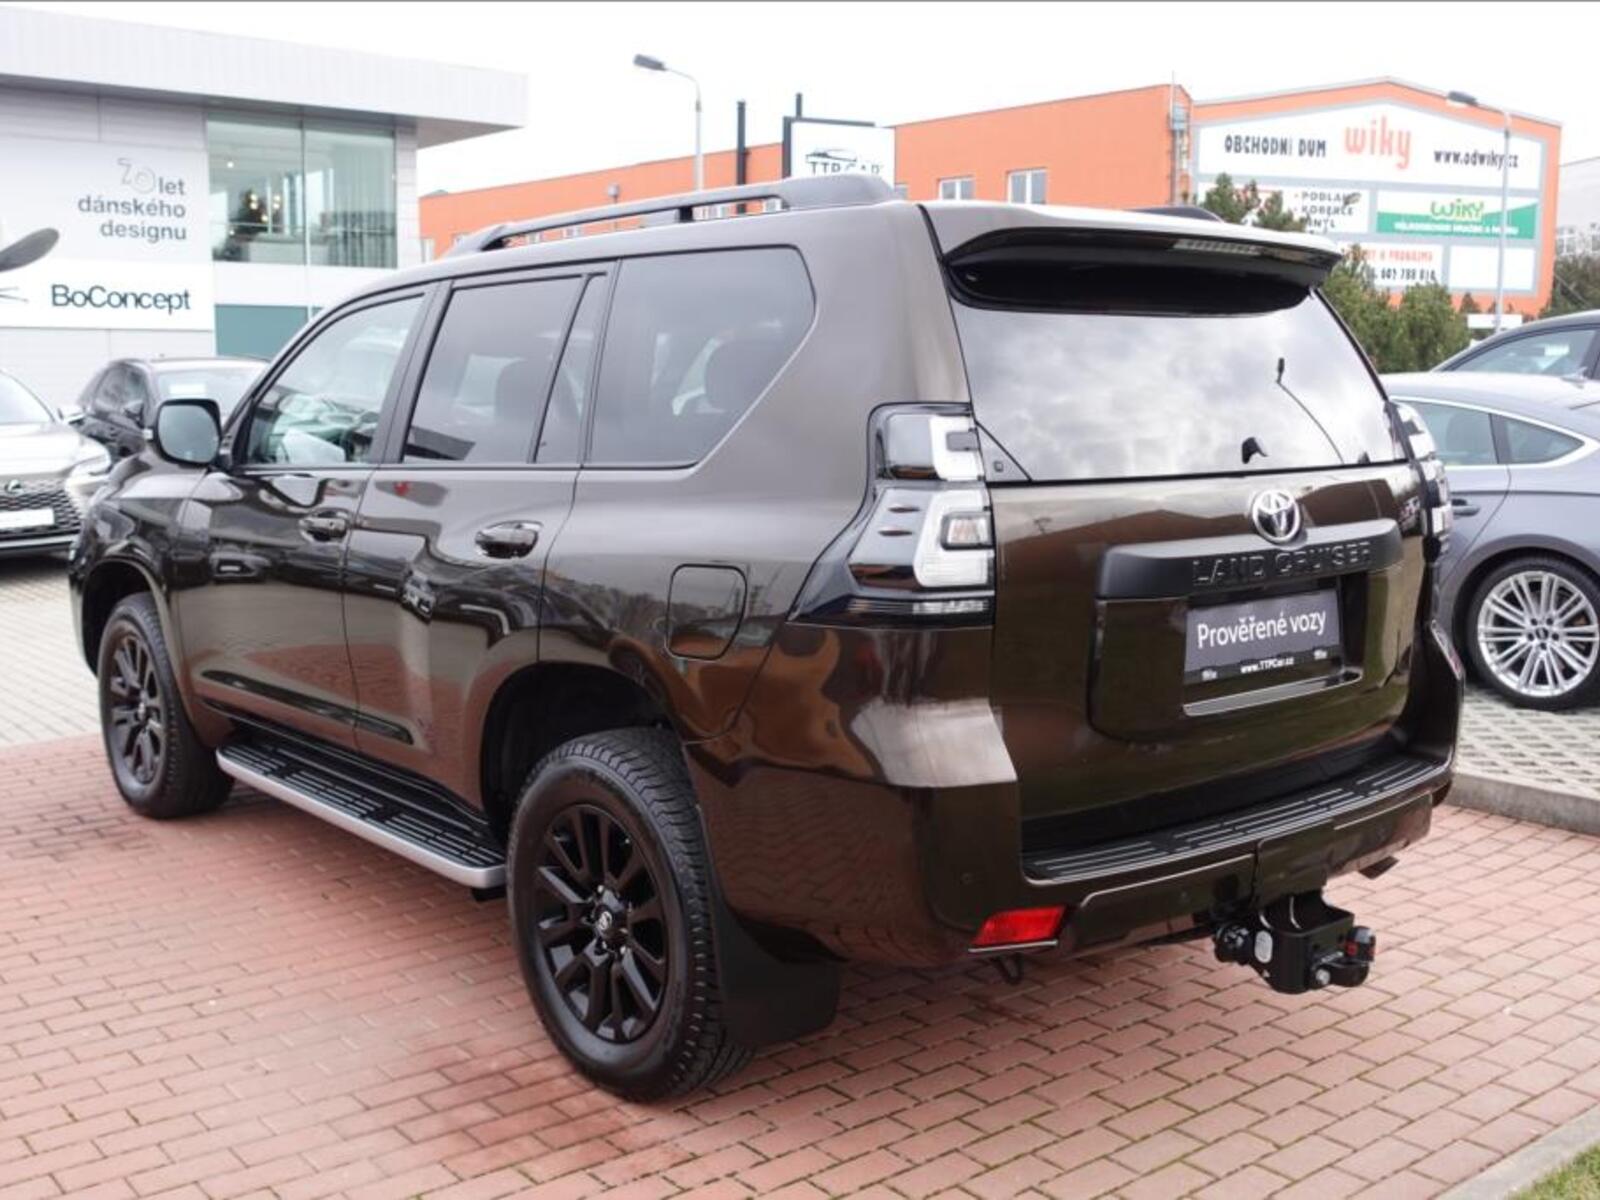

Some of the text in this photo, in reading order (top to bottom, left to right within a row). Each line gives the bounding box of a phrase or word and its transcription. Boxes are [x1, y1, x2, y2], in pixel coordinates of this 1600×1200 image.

[1344, 115, 1412, 170] wiky
[1434, 148, 1519, 170] www.odwikycz
[158, 176, 186, 195] let
[78, 195, 187, 219] dánského
[100, 219, 187, 244] designu
[50, 283, 191, 316] BoConcept
[1192, 554, 1266, 587] LAND
[1197, 610, 1327, 649] Prověřené vozy
